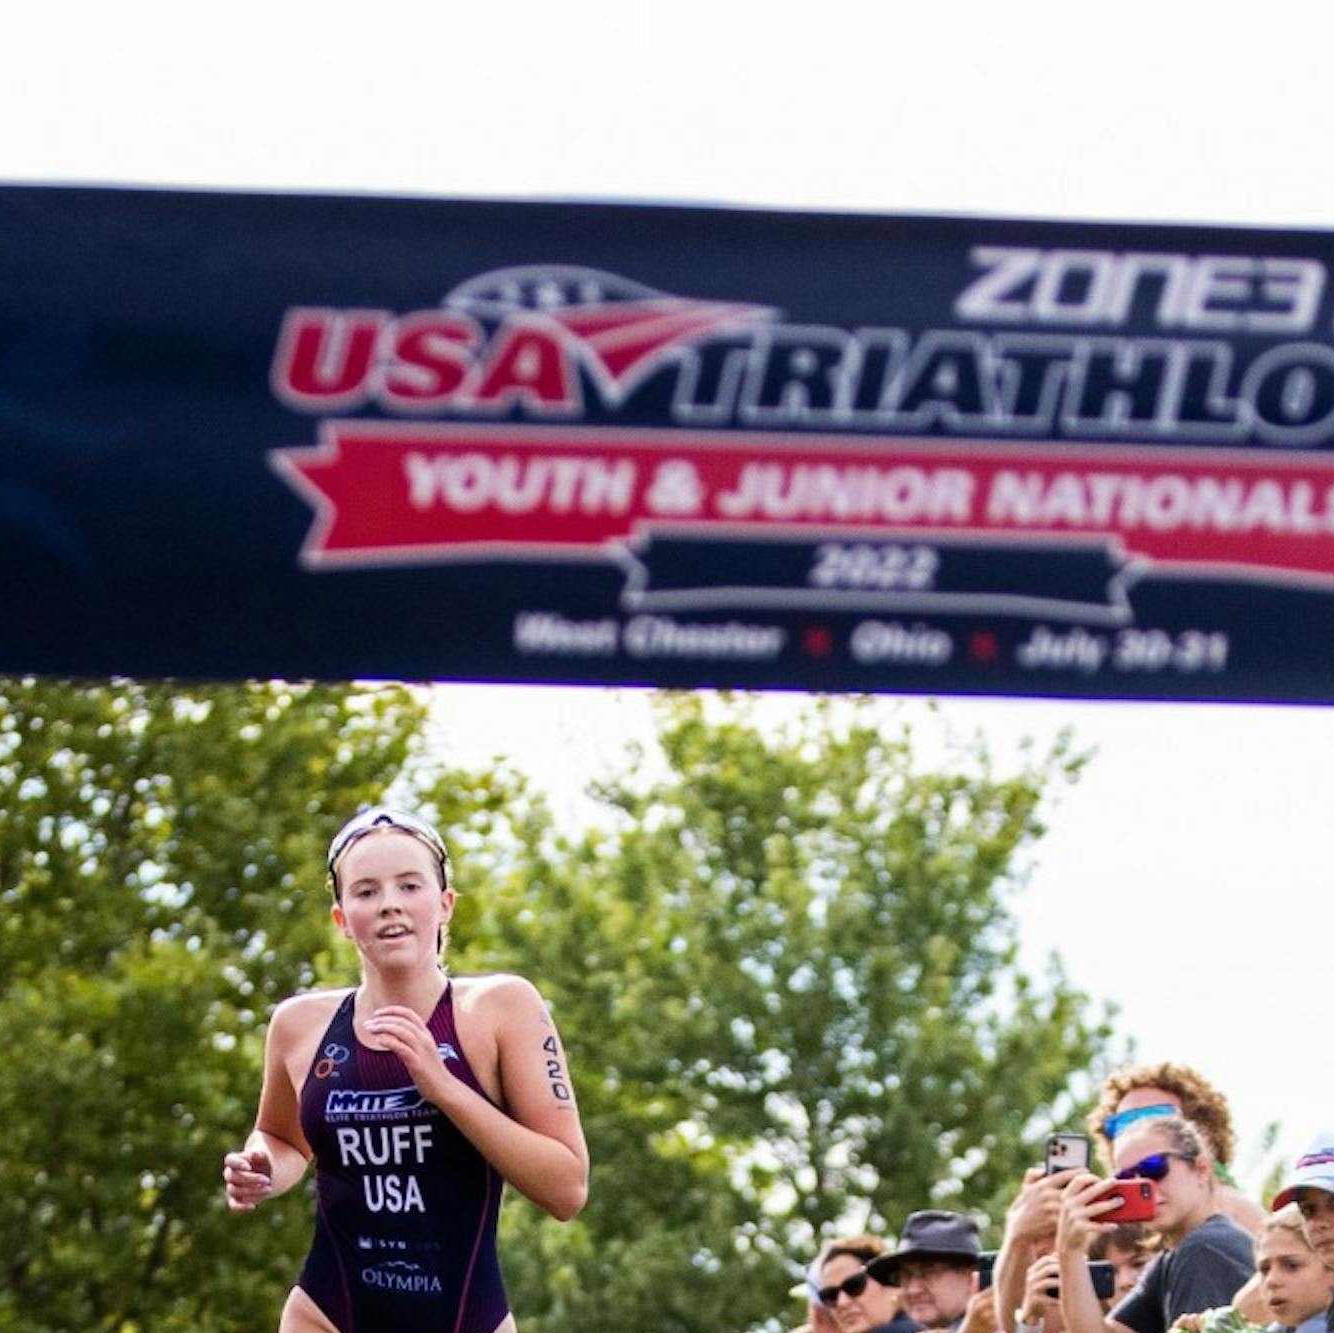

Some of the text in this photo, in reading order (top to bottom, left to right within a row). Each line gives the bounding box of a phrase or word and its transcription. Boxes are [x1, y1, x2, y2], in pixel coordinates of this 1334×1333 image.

[955, 246, 1327, 335] ZONE3
[269, 305, 583, 414] USA
[404, 452, 636, 515] YOUTH
[645, 458, 703, 517] &
[717, 463, 975, 527] JUNIOR
[810, 541, 939, 590] 2022
[512, 611, 617, 656] West
[623, 614, 787, 659] Chester
[337, 1124, 434, 1167] RUFF
[363, 1174, 426, 1213] USA
[362, 1266, 443, 1292] OLYMPIA
